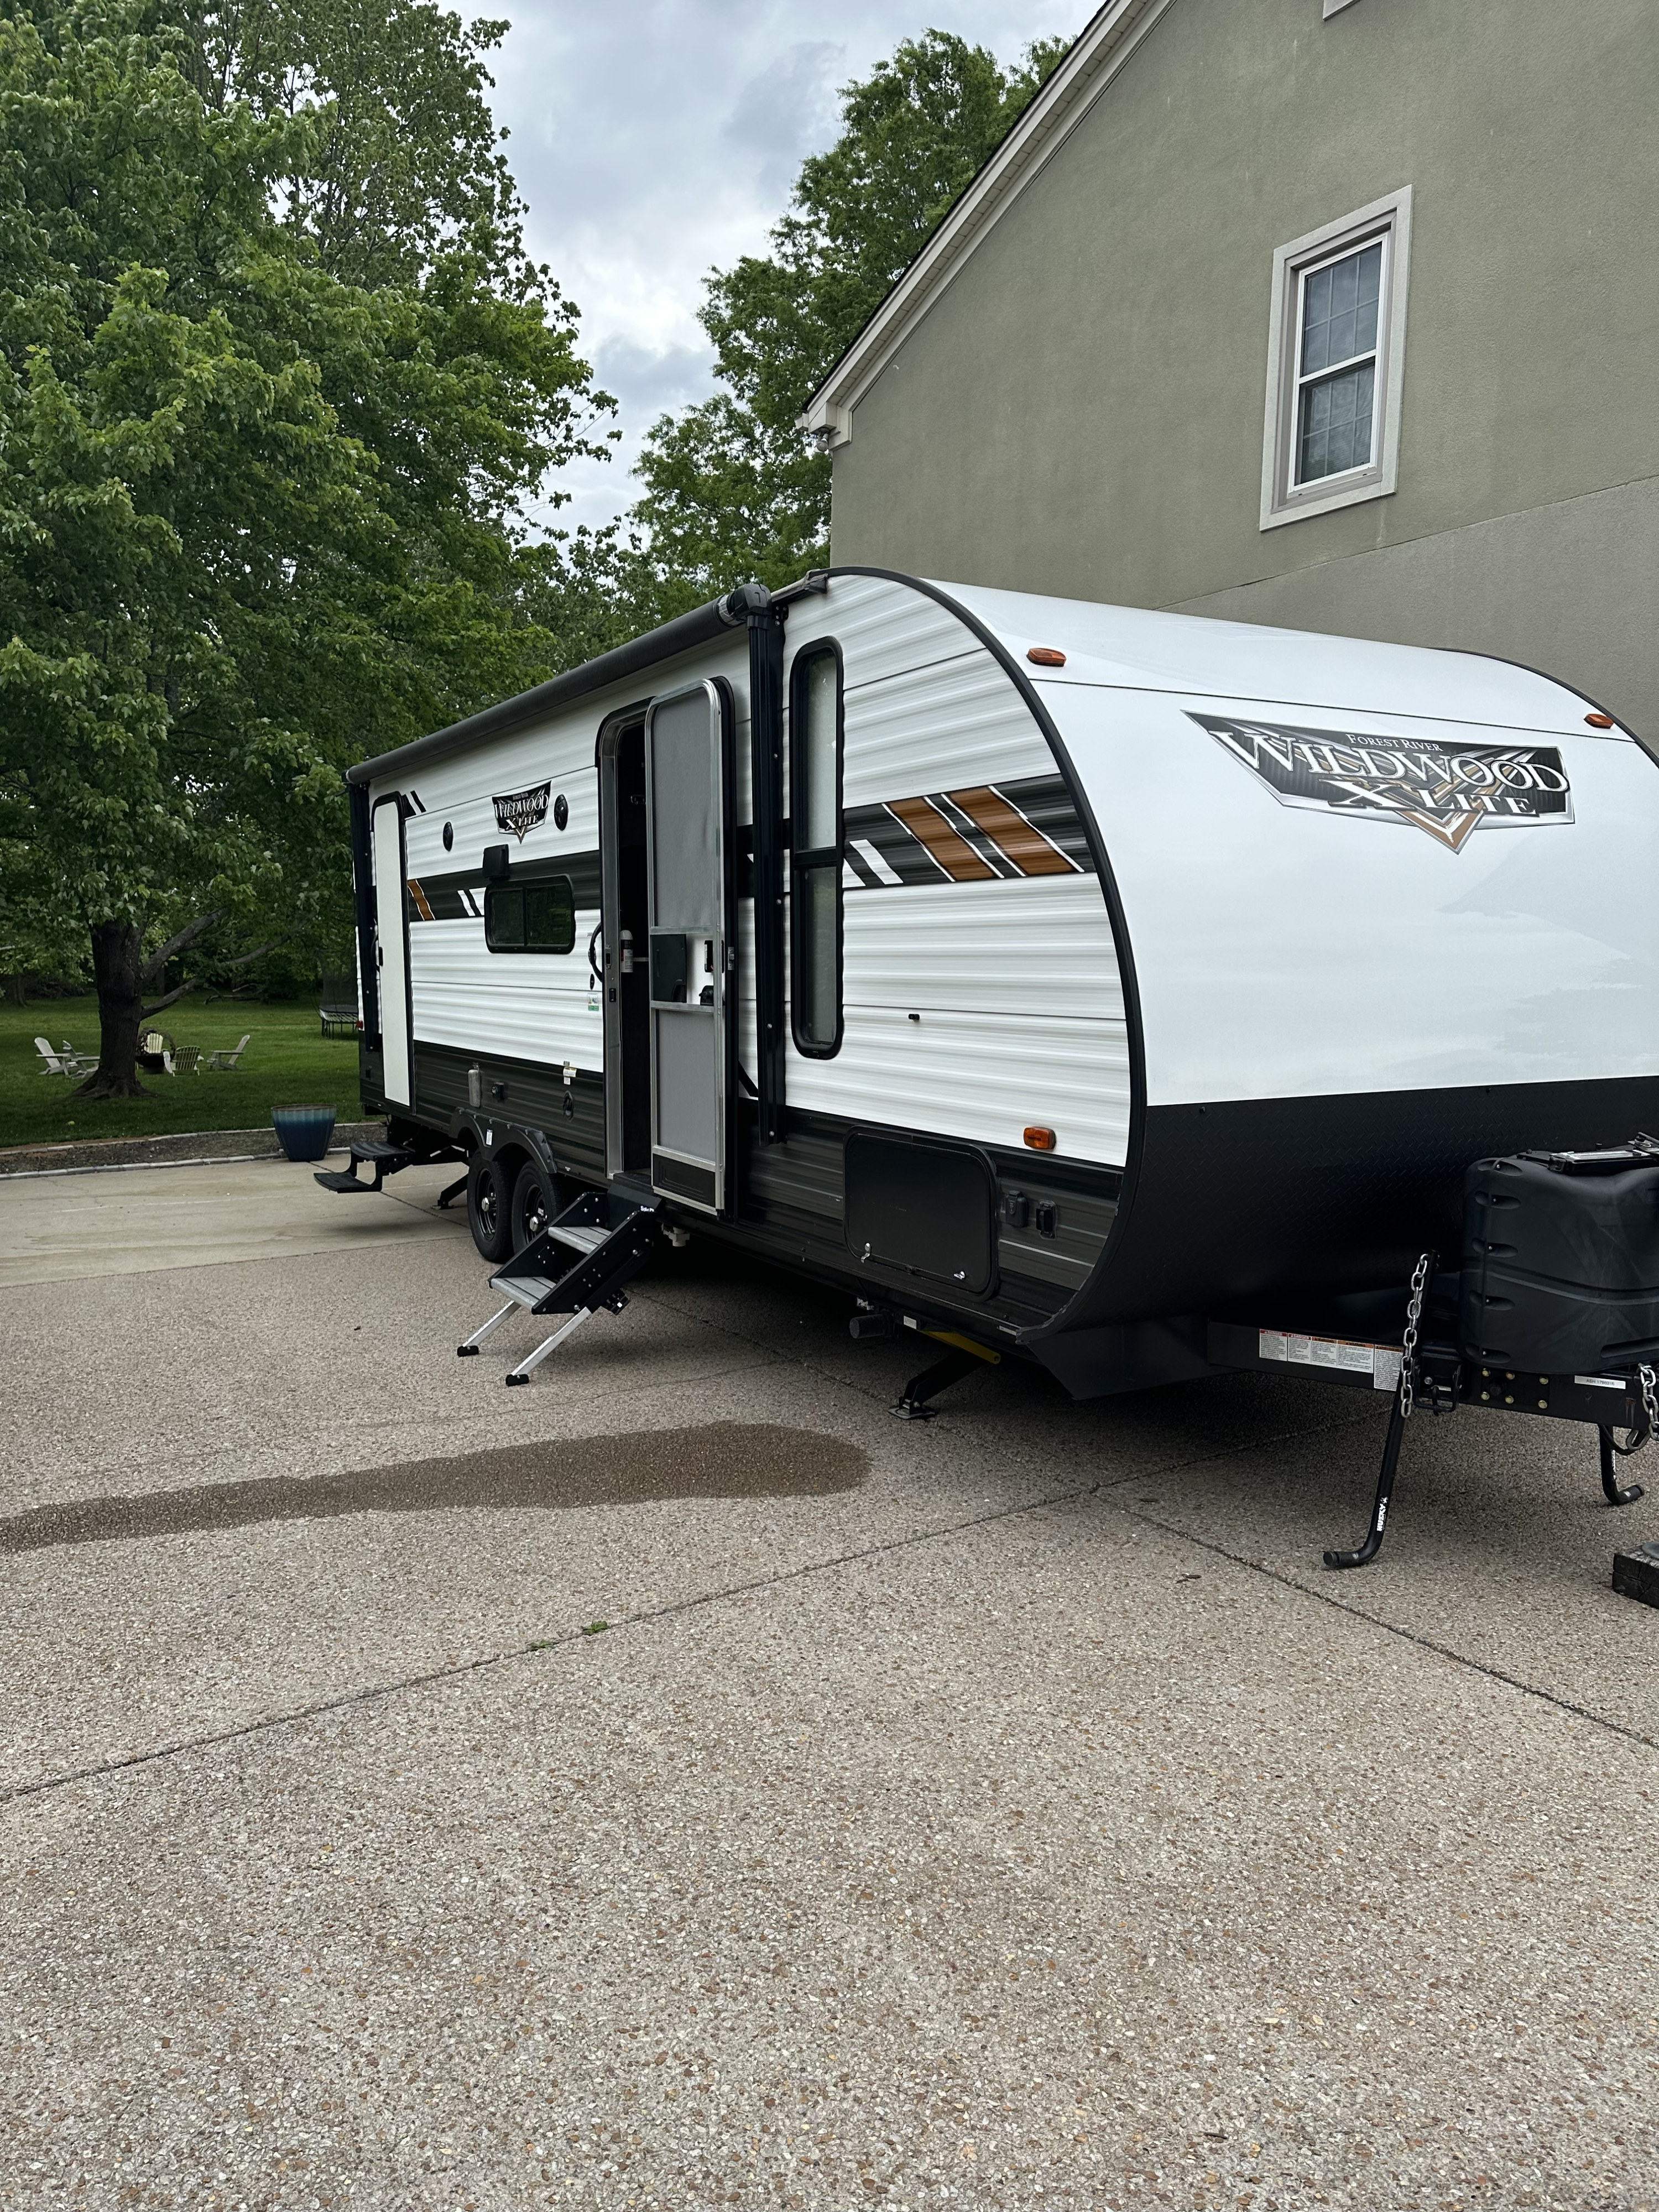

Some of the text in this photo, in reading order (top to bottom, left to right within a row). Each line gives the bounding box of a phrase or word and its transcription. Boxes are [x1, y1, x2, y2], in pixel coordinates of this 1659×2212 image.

[1345, 734, 1444, 752] FOREST RIVER
[1208, 729, 1571, 792] WILDWOOD
[494, 794, 548, 818] WILDWOOD
[1412, 788, 1540, 817] LITE
[518, 815, 539, 826] LITE
